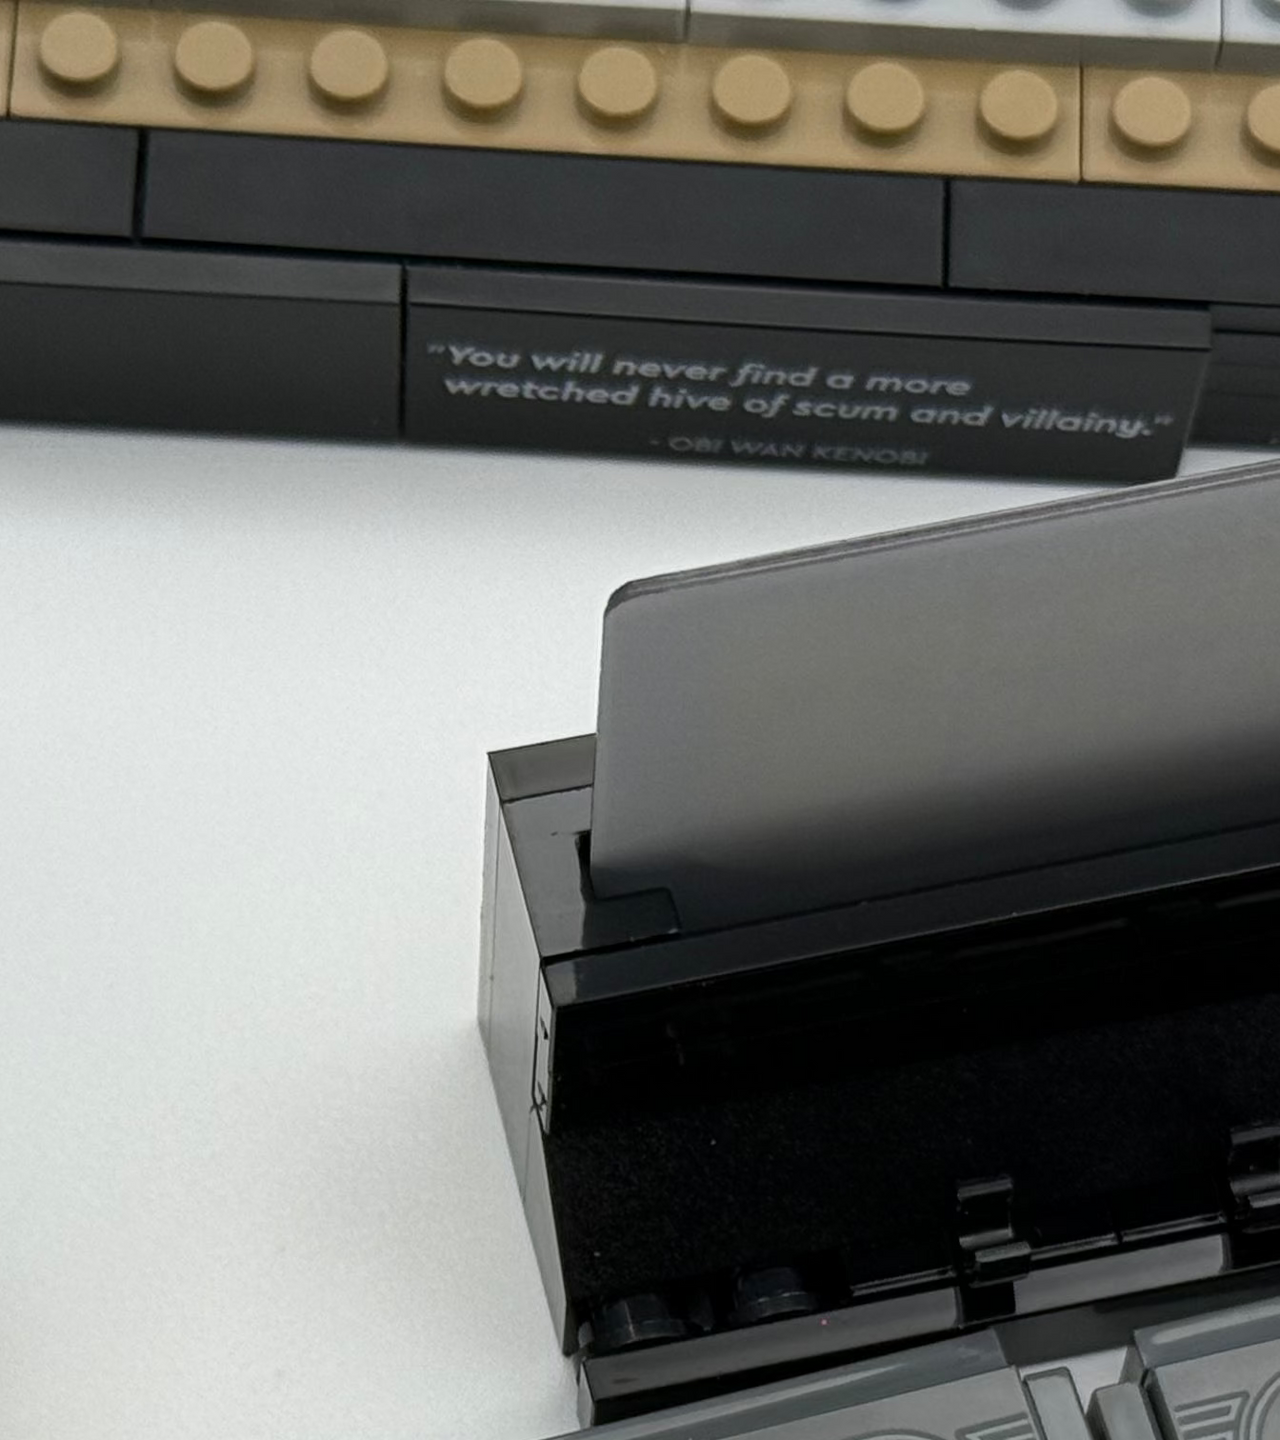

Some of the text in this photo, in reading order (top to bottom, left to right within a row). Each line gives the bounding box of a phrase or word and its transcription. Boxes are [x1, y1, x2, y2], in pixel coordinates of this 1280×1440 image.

[531, 351, 605, 374] will
[612, 357, 726, 382] never
[730, 362, 818, 388] find
[826, 372, 855, 391] a
[866, 374, 972, 396] more
[443, 377, 640, 406] wretched
[648, 386, 731, 412] hive
[743, 392, 790, 419] of
[792, 400, 898, 422] scum
[911, 405, 994, 427] and
[729, 438, 804, 458] WAN
[813, 445, 931, 465] KENOBI
